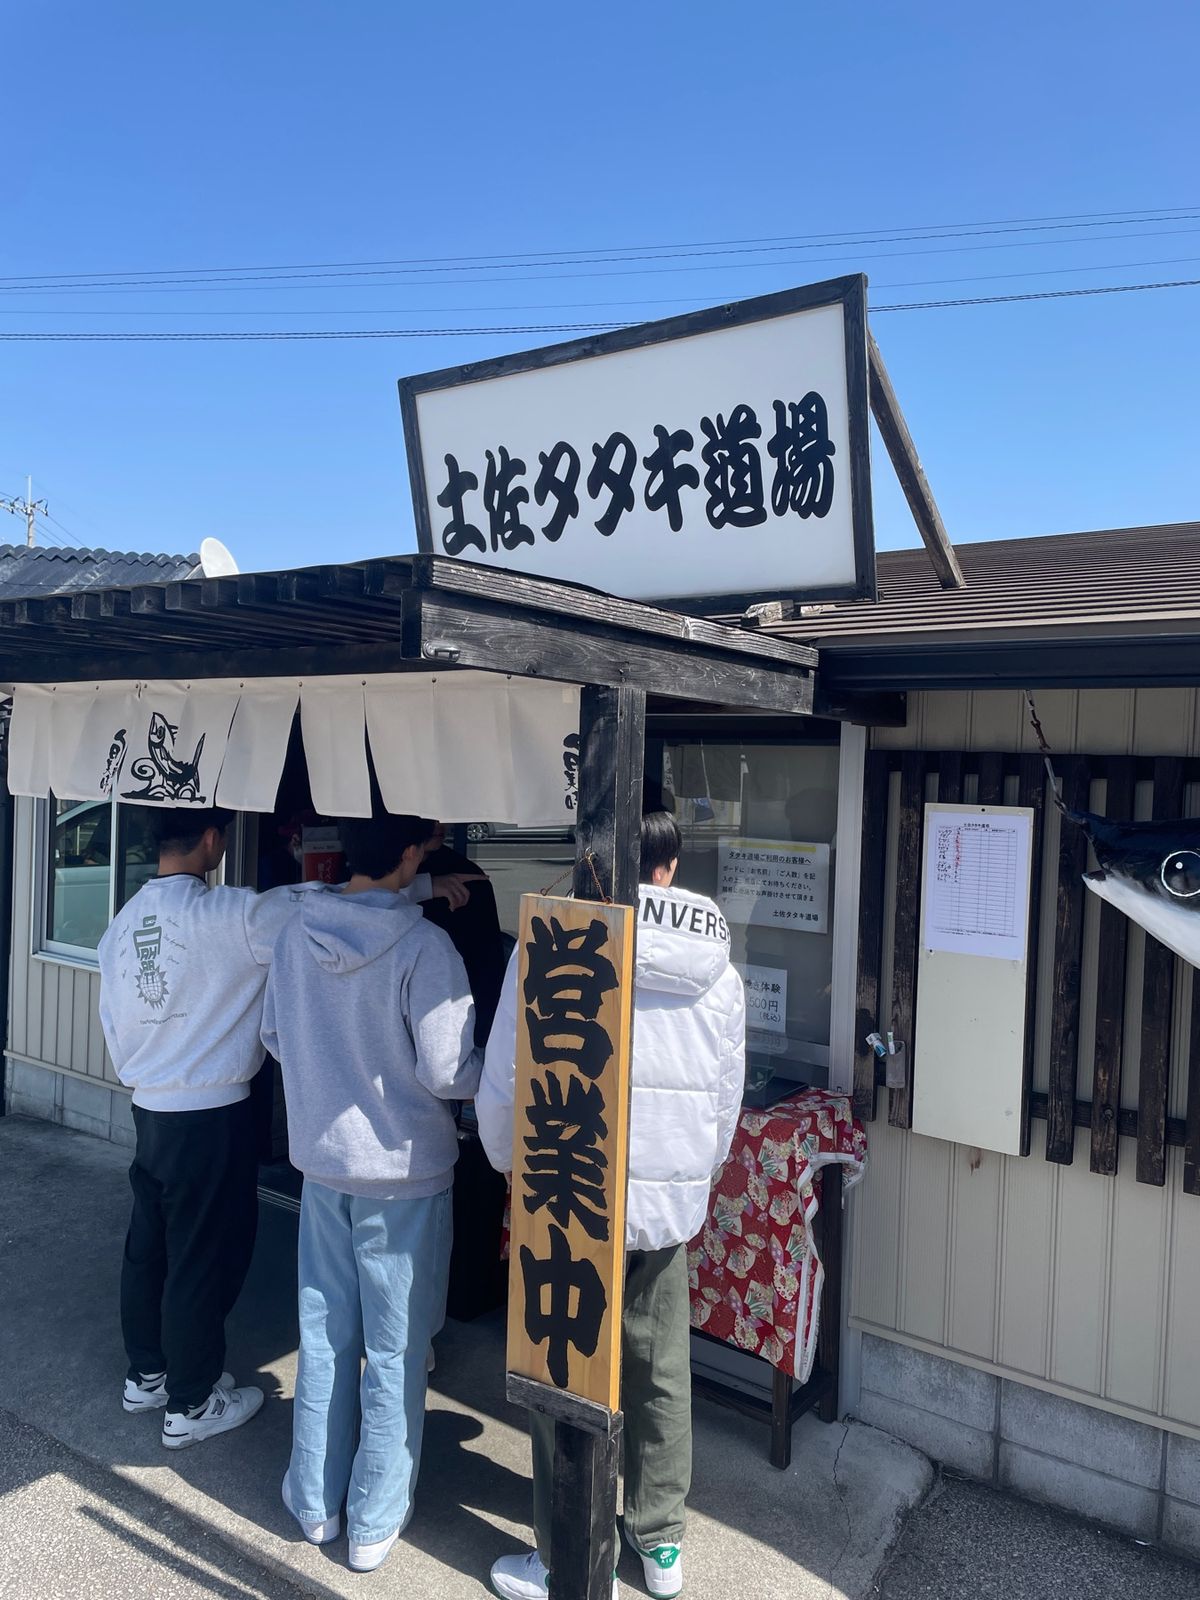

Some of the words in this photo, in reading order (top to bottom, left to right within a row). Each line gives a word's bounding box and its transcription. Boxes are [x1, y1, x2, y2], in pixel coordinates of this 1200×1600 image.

[437, 391, 836, 556] 土佐タタキ道場
[773, 909, 819, 921] 土佐タタキ道場
[520, 916, 619, 1388] 営業中
